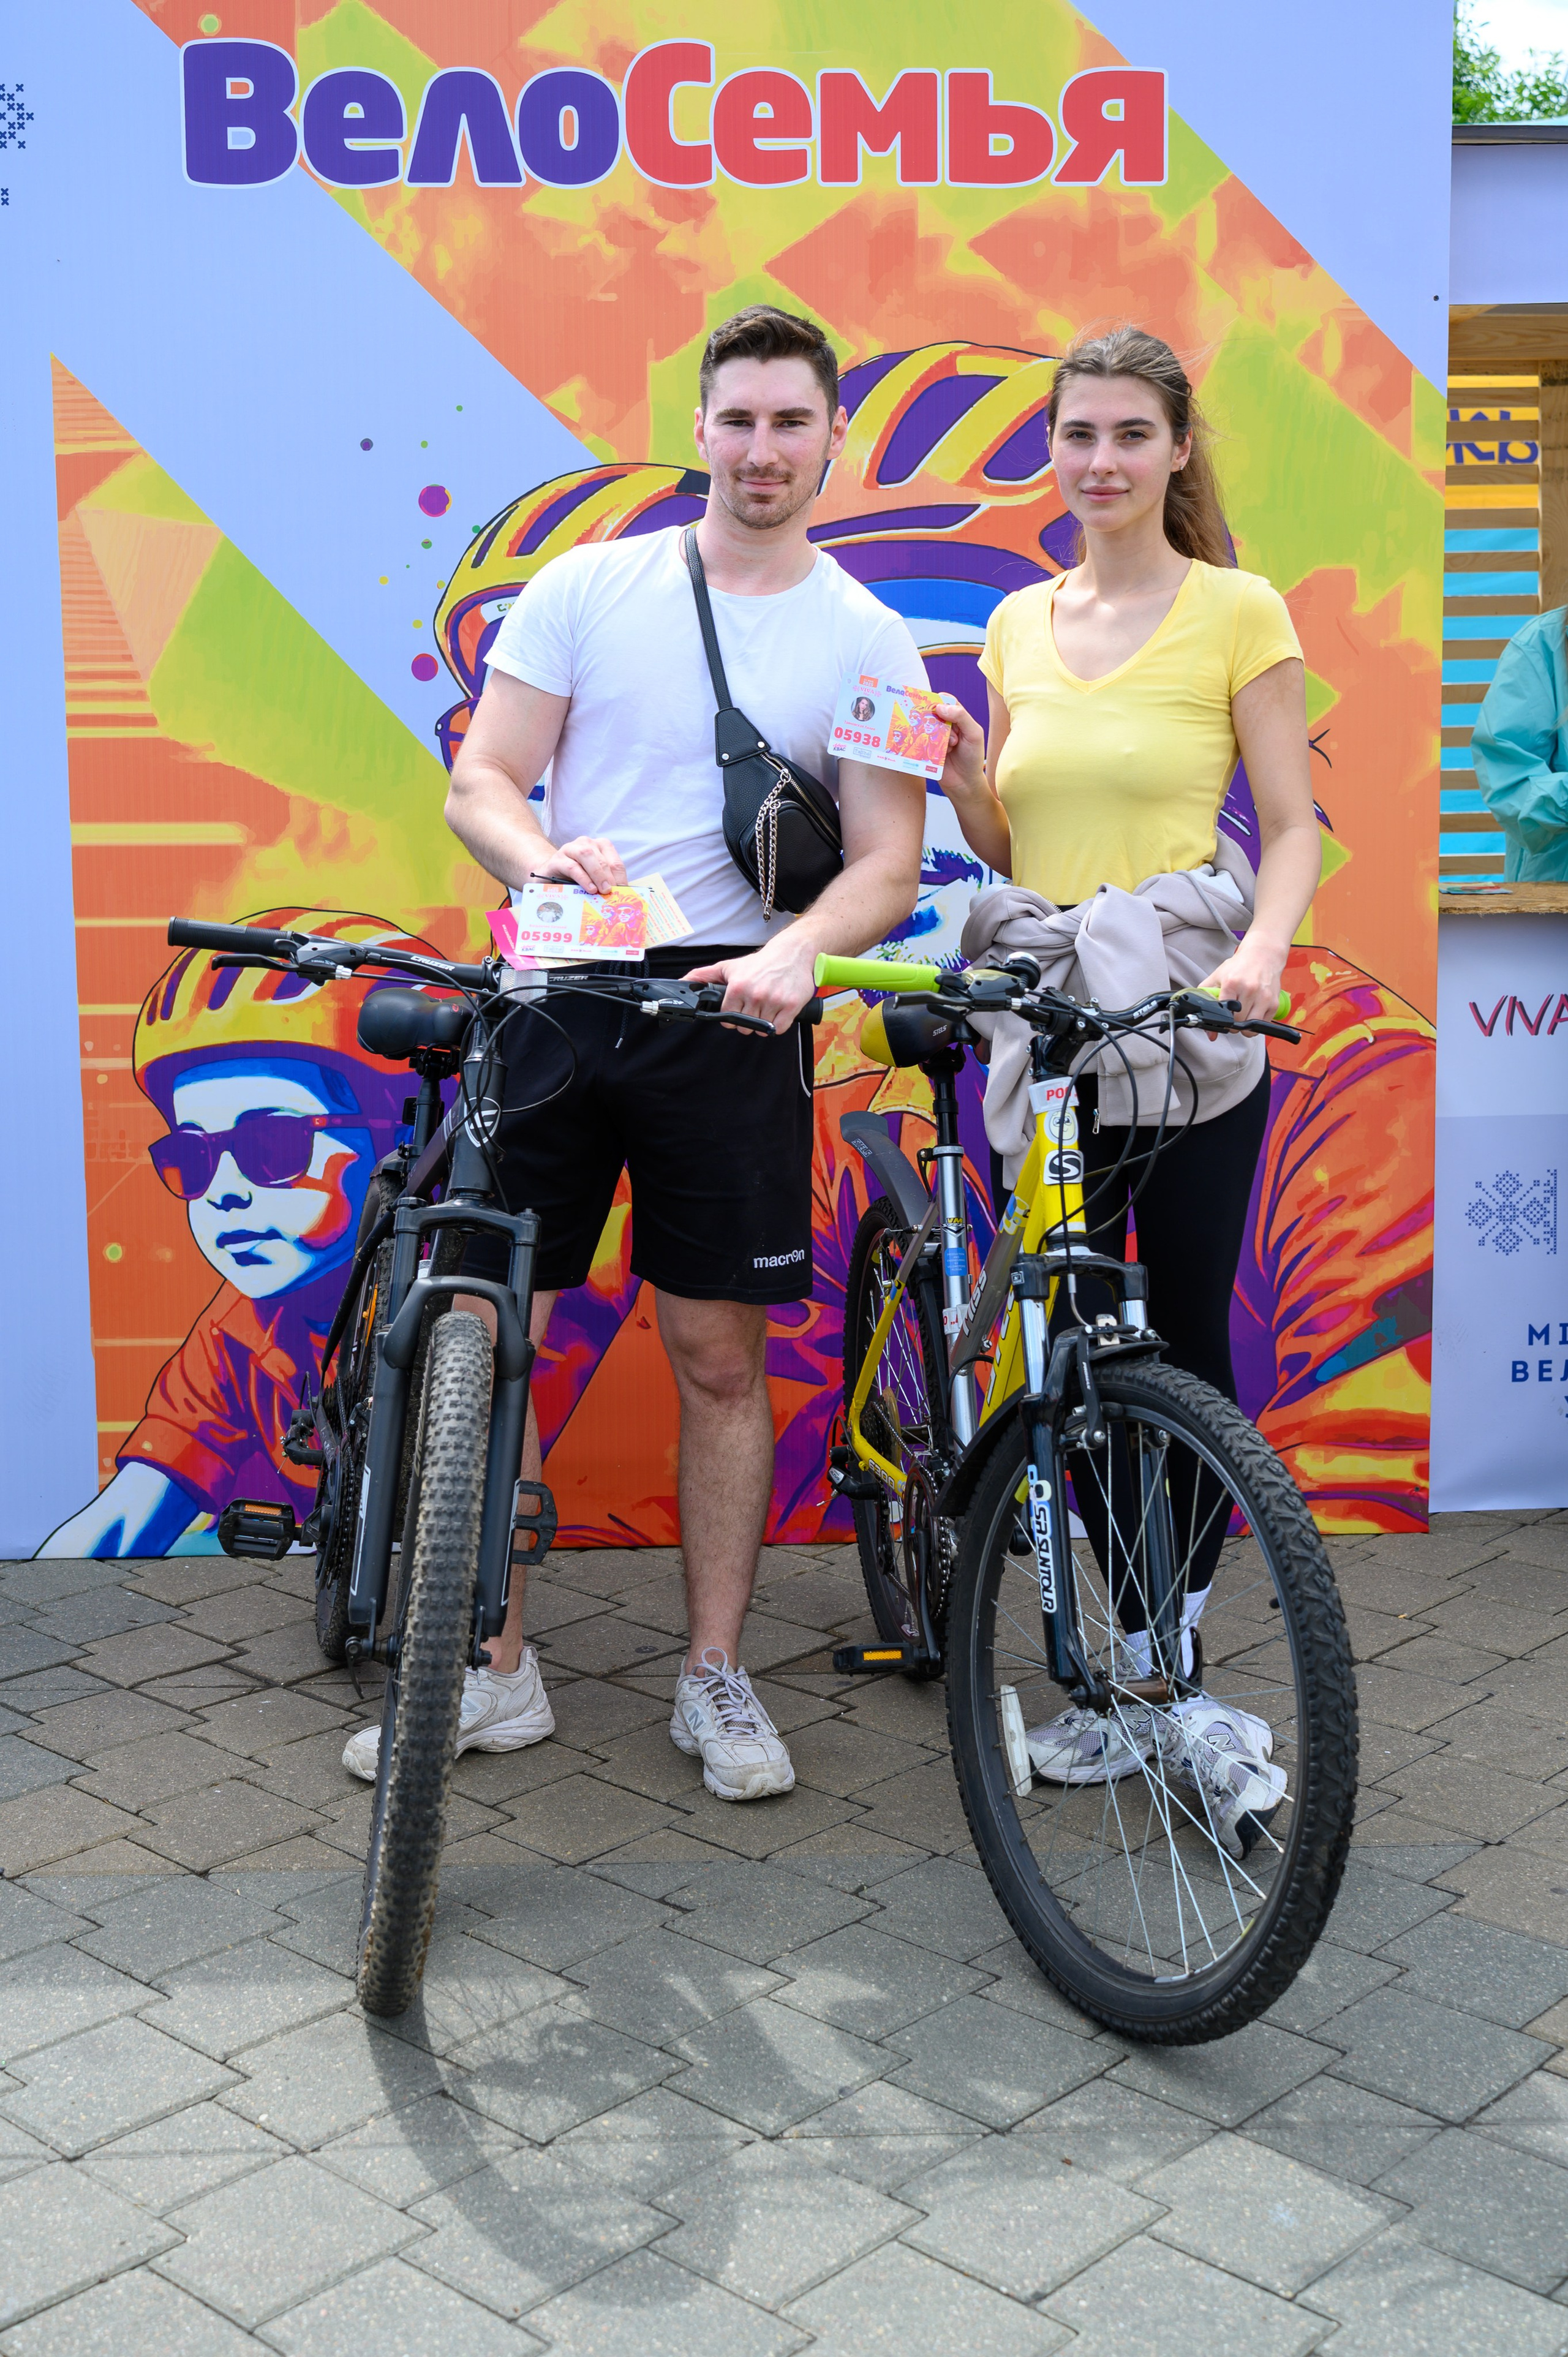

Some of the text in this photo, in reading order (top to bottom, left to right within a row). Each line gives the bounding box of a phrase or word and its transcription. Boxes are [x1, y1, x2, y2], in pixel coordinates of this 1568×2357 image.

[182, 39, 1169, 188] ВелоСемья
[834, 726, 881, 748] 05938
[521, 930, 573, 943] 05999
[410, 956, 455, 971] CRUZER
[932, 1024, 948, 1036] STELS
[851, 1138, 873, 1158] STELS
[753, 1249, 804, 1269] macron
[1036, 1536, 1055, 1610] SUNTOUR
